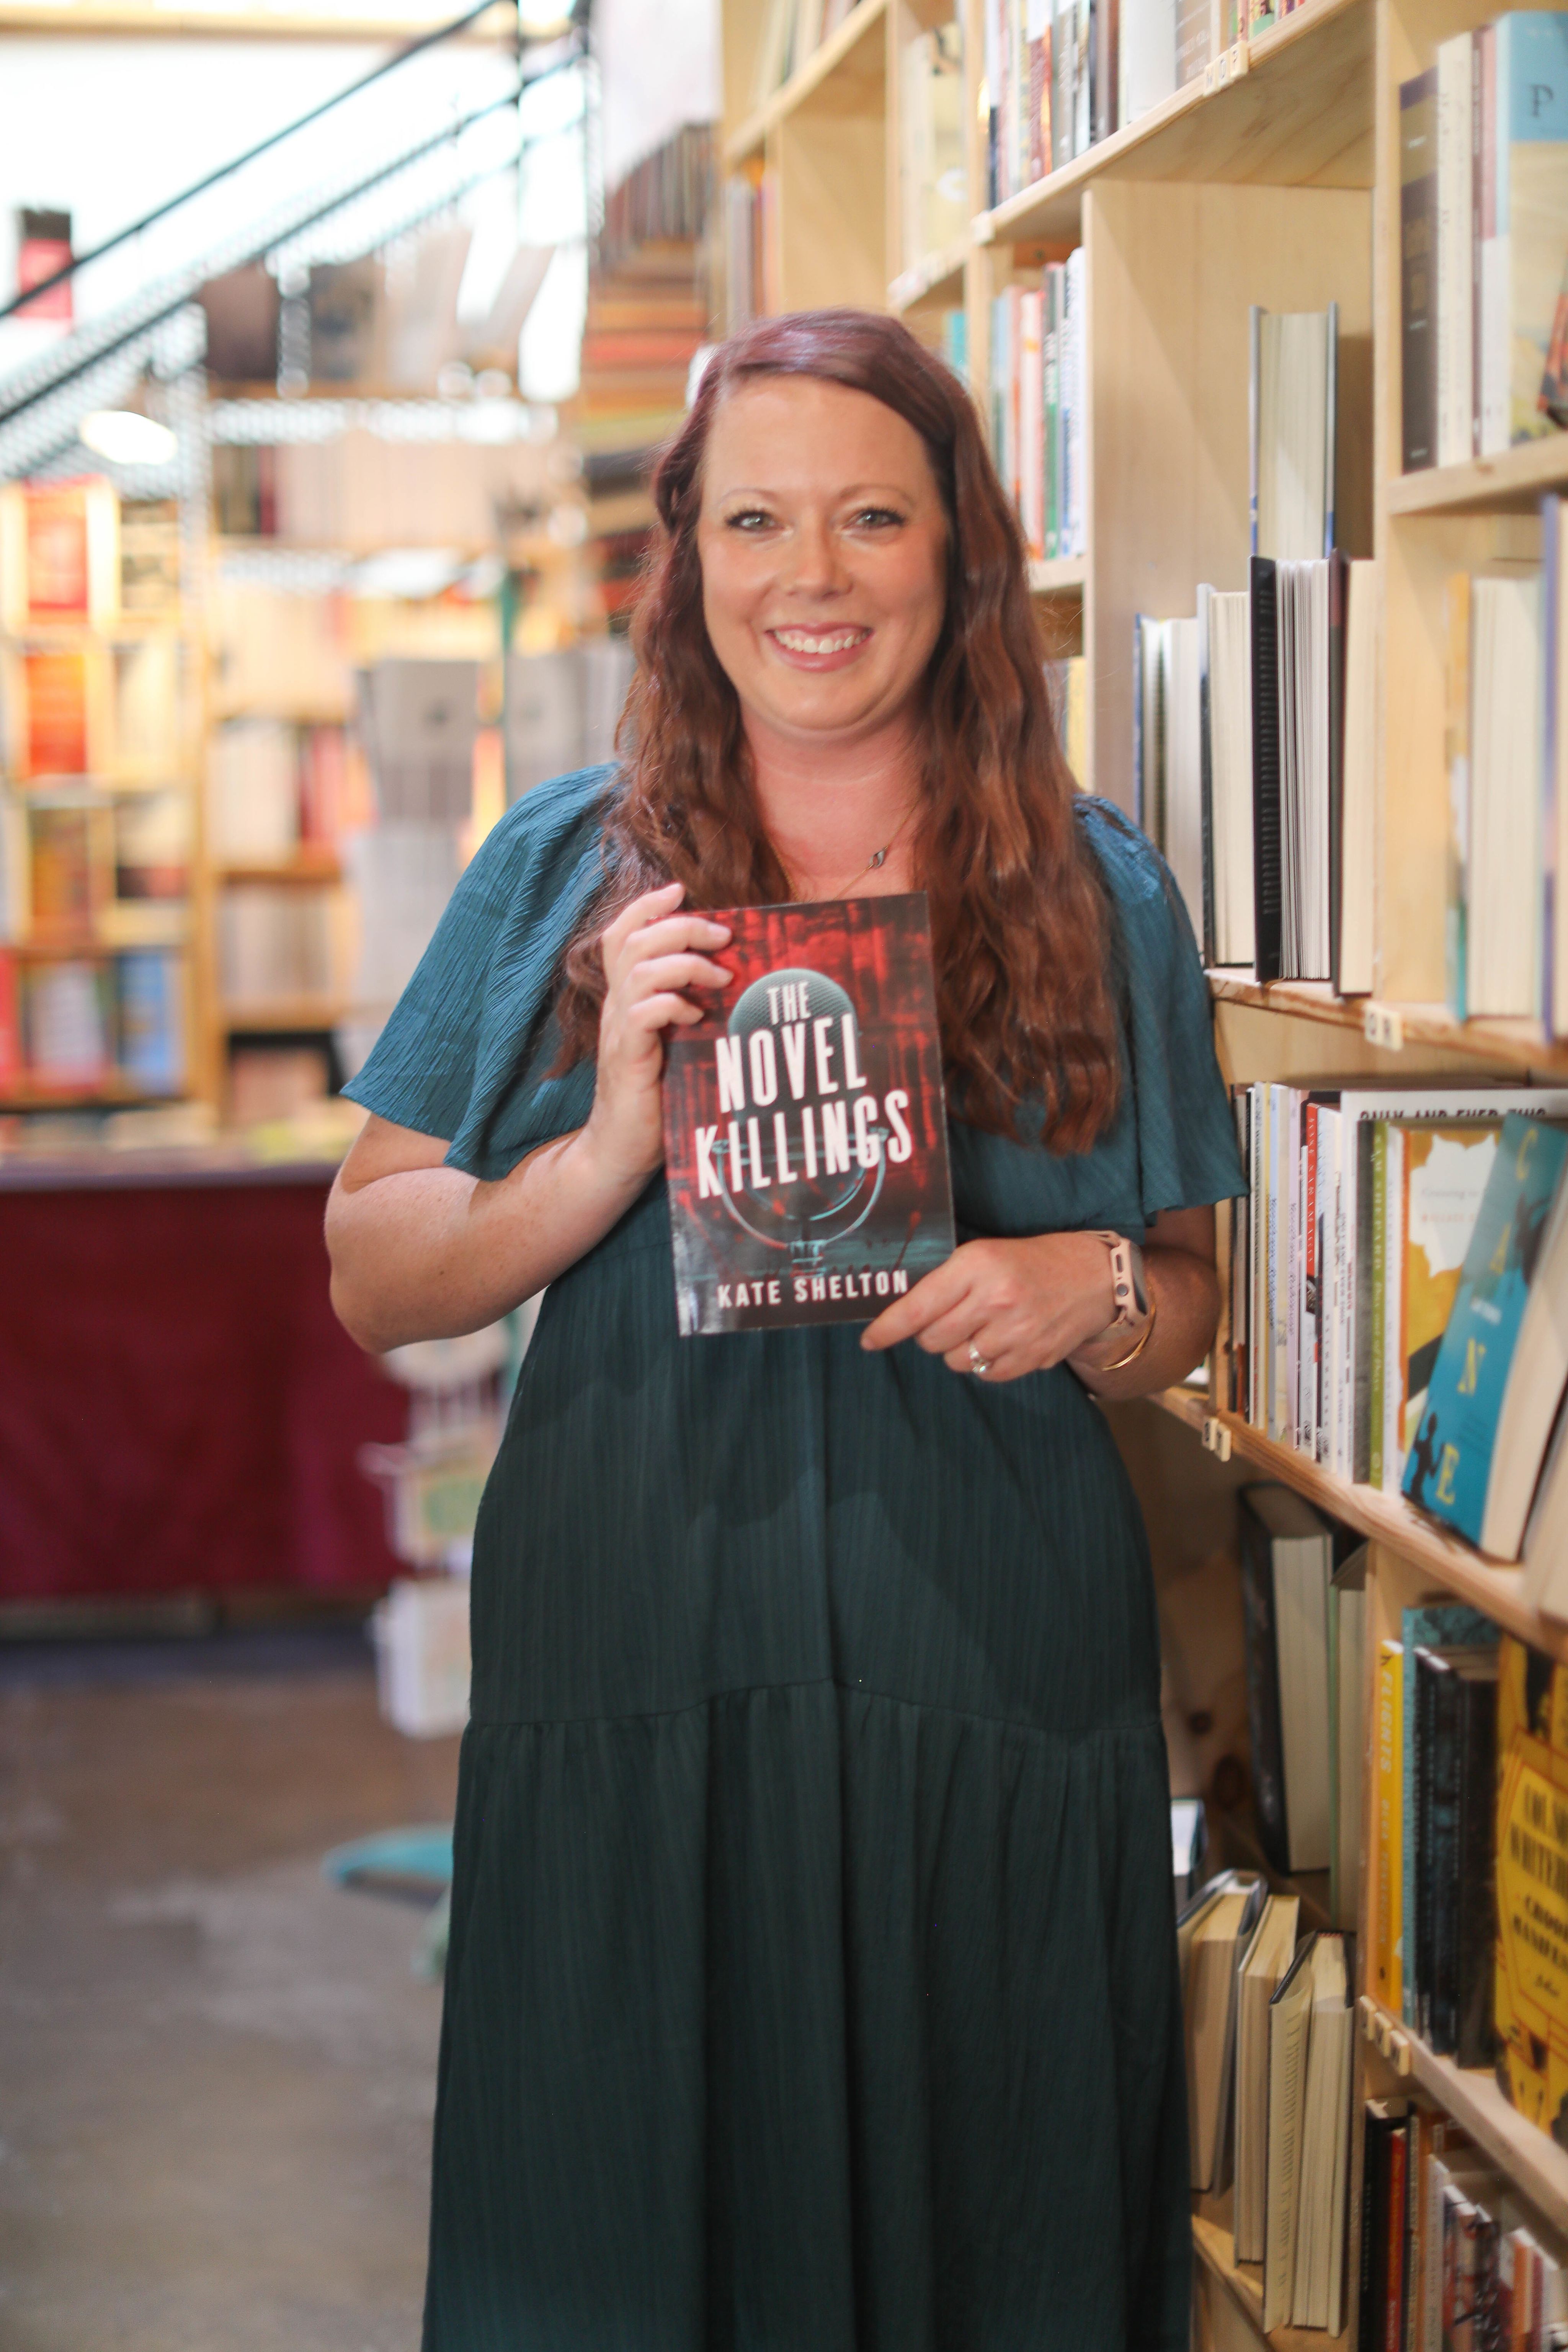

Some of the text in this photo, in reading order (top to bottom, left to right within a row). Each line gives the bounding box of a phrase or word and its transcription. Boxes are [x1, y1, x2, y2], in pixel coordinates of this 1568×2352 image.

[768, 981, 810, 1024] THE
[715, 1013, 866, 1113] NOVEL
[694, 1088, 913, 1199] KILLINGS
[718, 1269, 909, 1309] KATE SHELTON
[1380, 1671, 1393, 1773] FLIGHTS
